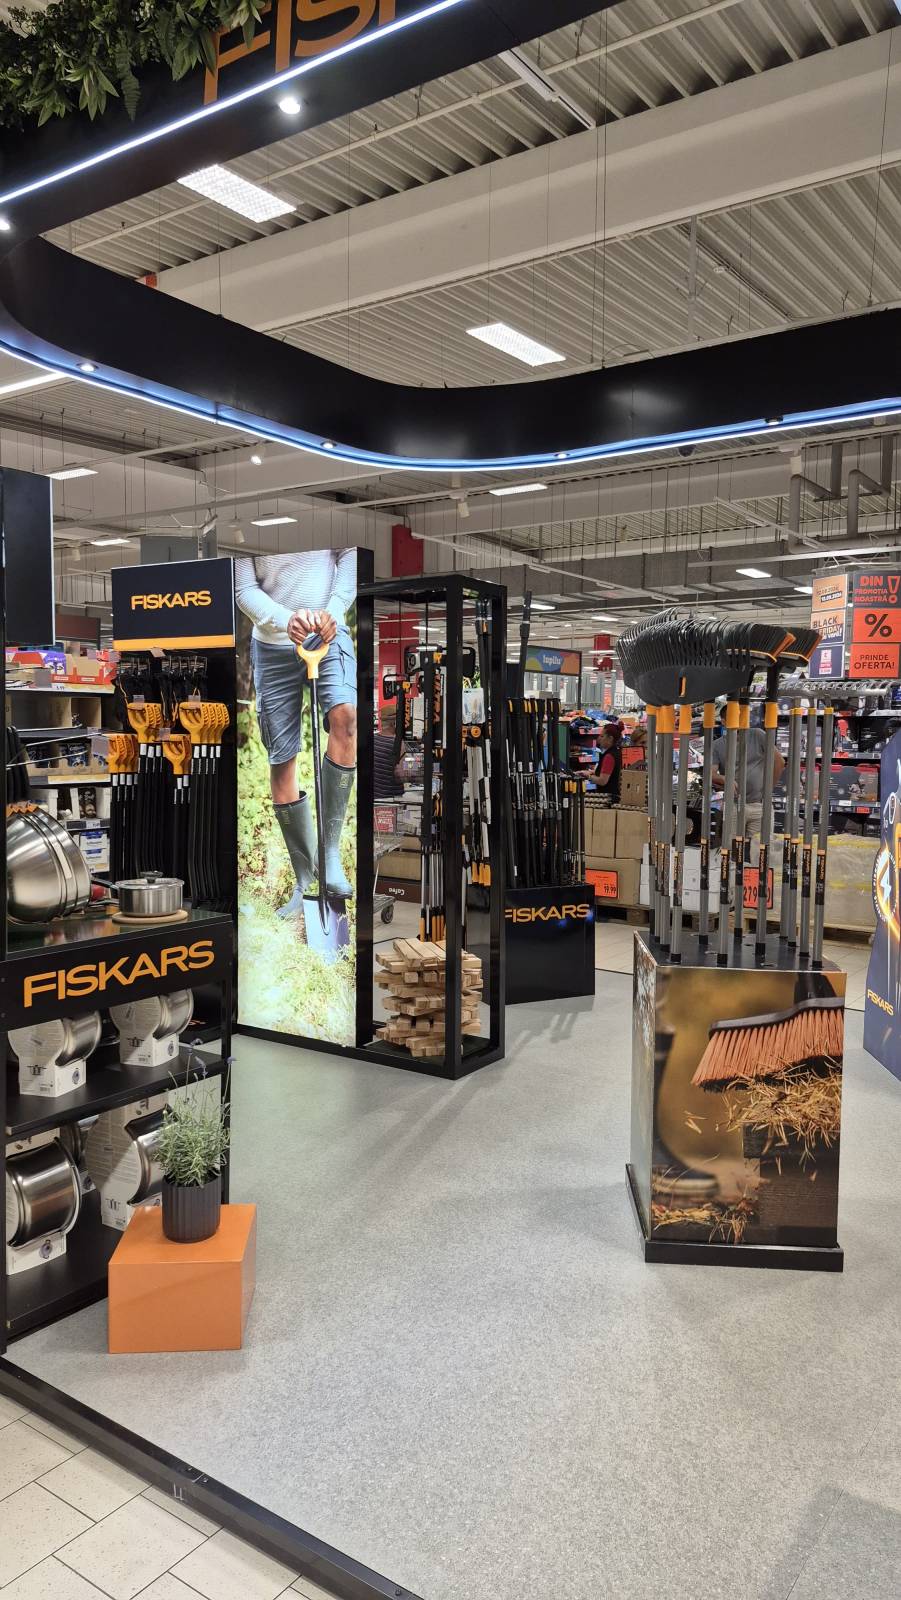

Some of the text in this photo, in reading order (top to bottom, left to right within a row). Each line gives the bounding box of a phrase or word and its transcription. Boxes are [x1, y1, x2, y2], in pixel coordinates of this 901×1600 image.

[204, 0, 396, 106] FIS
[860, 575, 883, 587] DIN
[131, 590, 212, 610] FISKARS
[813, 616, 838, 628] BLACK
[819, 624, 841, 637] FRIDAY
[854, 661, 895, 670] OFERTA!
[24, 940, 215, 1008] FISKARS
[867, 989, 894, 1016] FISKARS
